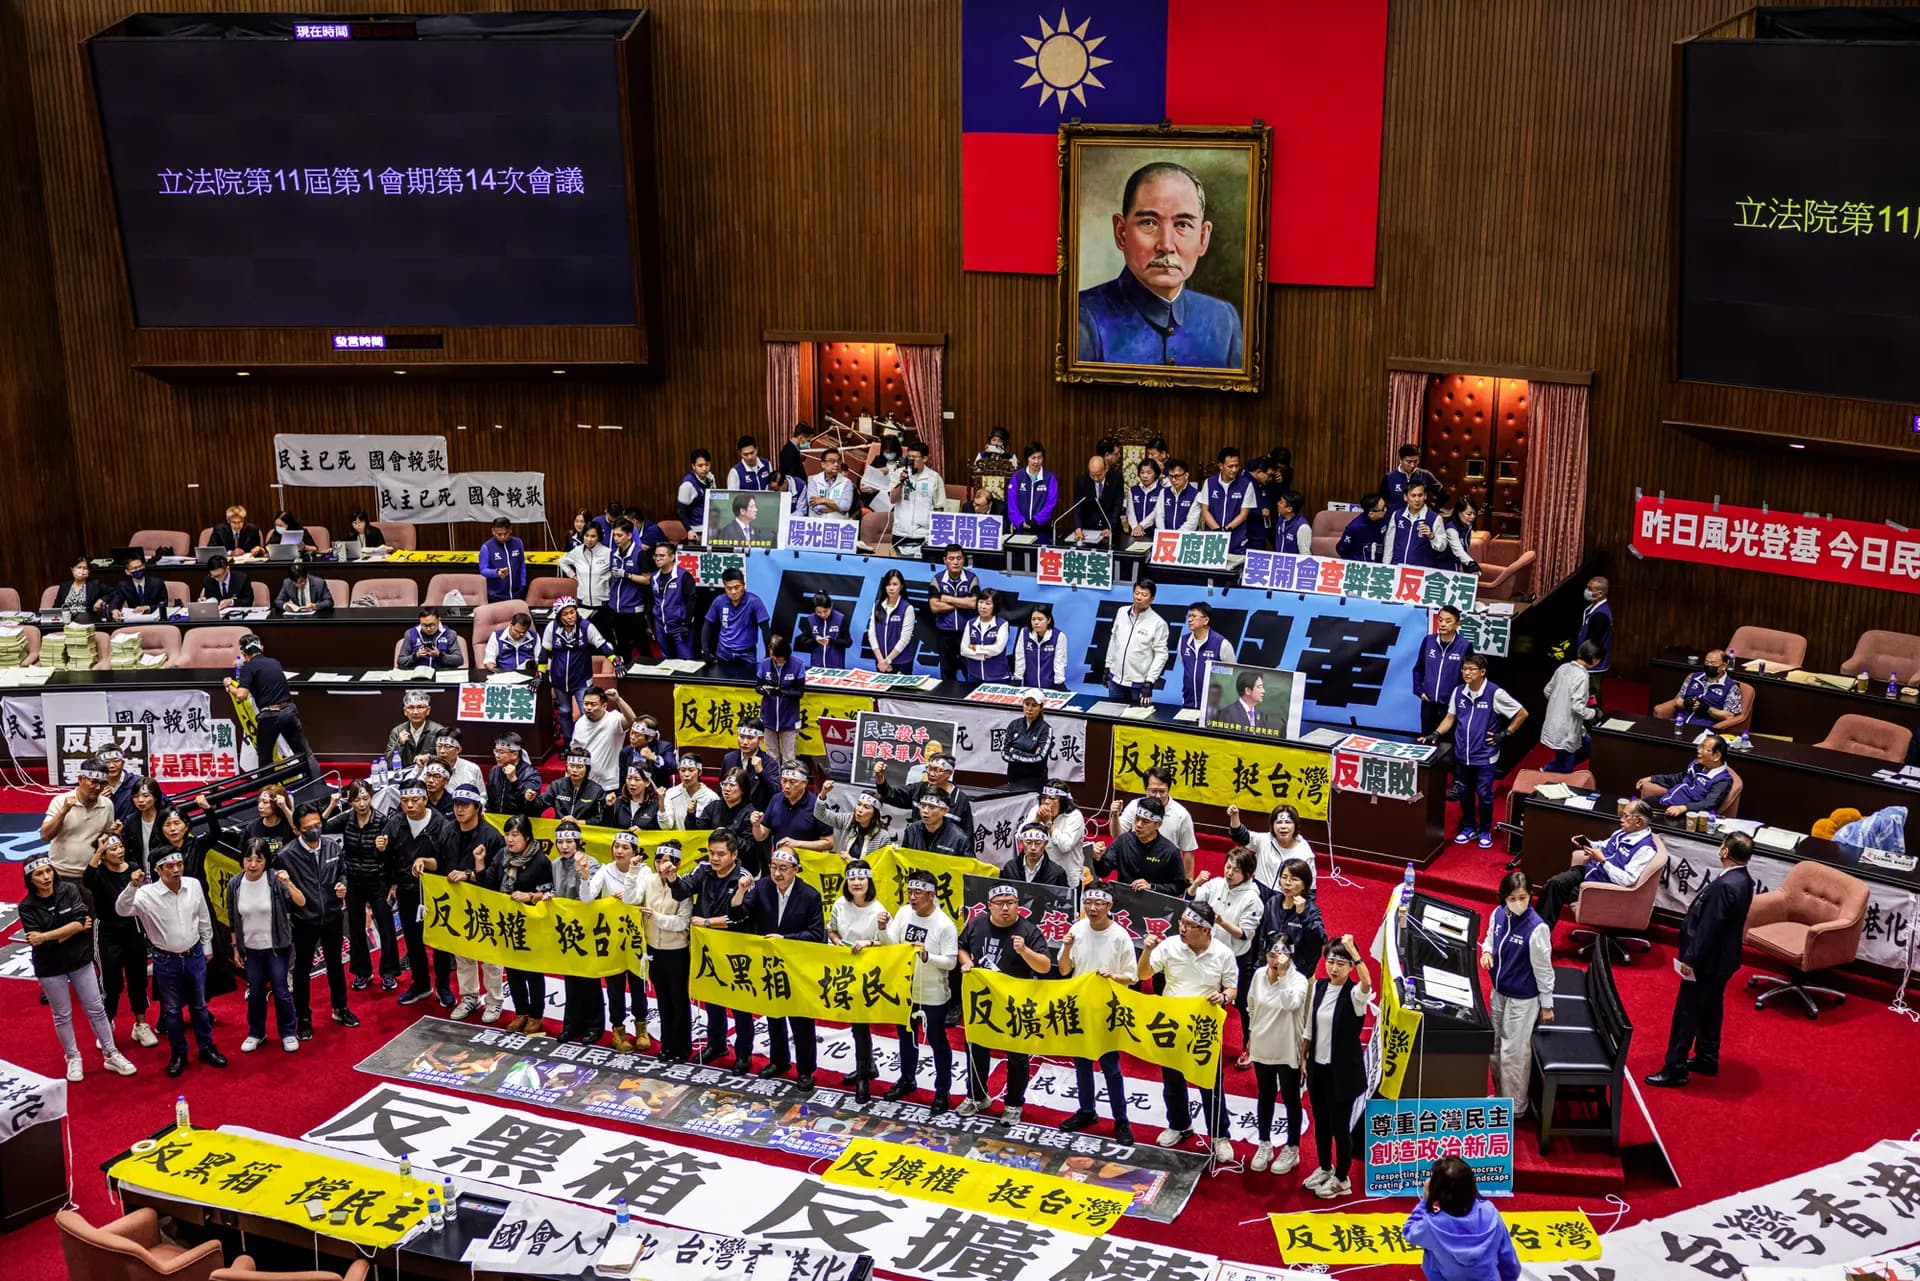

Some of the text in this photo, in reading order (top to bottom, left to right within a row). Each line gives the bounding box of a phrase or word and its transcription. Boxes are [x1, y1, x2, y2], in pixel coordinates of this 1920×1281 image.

[296, 25, 348, 38] 現在時間
[156, 167, 585, 196] 立法院第11屆第1會期第14次會議
[1733, 196, 1920, 238] 立法院第11
[278, 449, 446, 472] 民主已死 國會輓歌
[381, 485, 544, 511] 民主已死 國會輓歌
[787, 519, 858, 550] 陽光國會
[930, 513, 1001, 550] 要開會
[1152, 531, 1230, 566] 反腐敗
[1641, 509, 1821, 565] 昨日風光登基
[1039, 549, 1112, 588] 查弊案
[460, 684, 535, 721] 查弊案
[864, 721, 929, 744] 民主殺手
[1232, 756, 1329, 806] 挺台灣
[1333, 752, 1416, 797] 反腐敗
[431, 892, 643, 960] 反擴權 挺台灣
[696, 942, 909, 1011] 反黑箱 撐民
[968, 988, 1219, 1066] 反擴權 挺台灣
[1371, 1106, 1510, 1138] 尊重台灣民主
[309, 1087, 727, 1217] 反黑箱
[1002, 1121, 1137, 1161] 武裝暴力
[1370, 1133, 1510, 1167] 創造政治新局
[134, 1140, 282, 1196] 反黑箱
[1369, 1181, 1403, 1191] Creating
[1375, 1170, 1420, 1181] Respecting
[834, 1149, 1125, 1228] 反擴權 挺台灣
